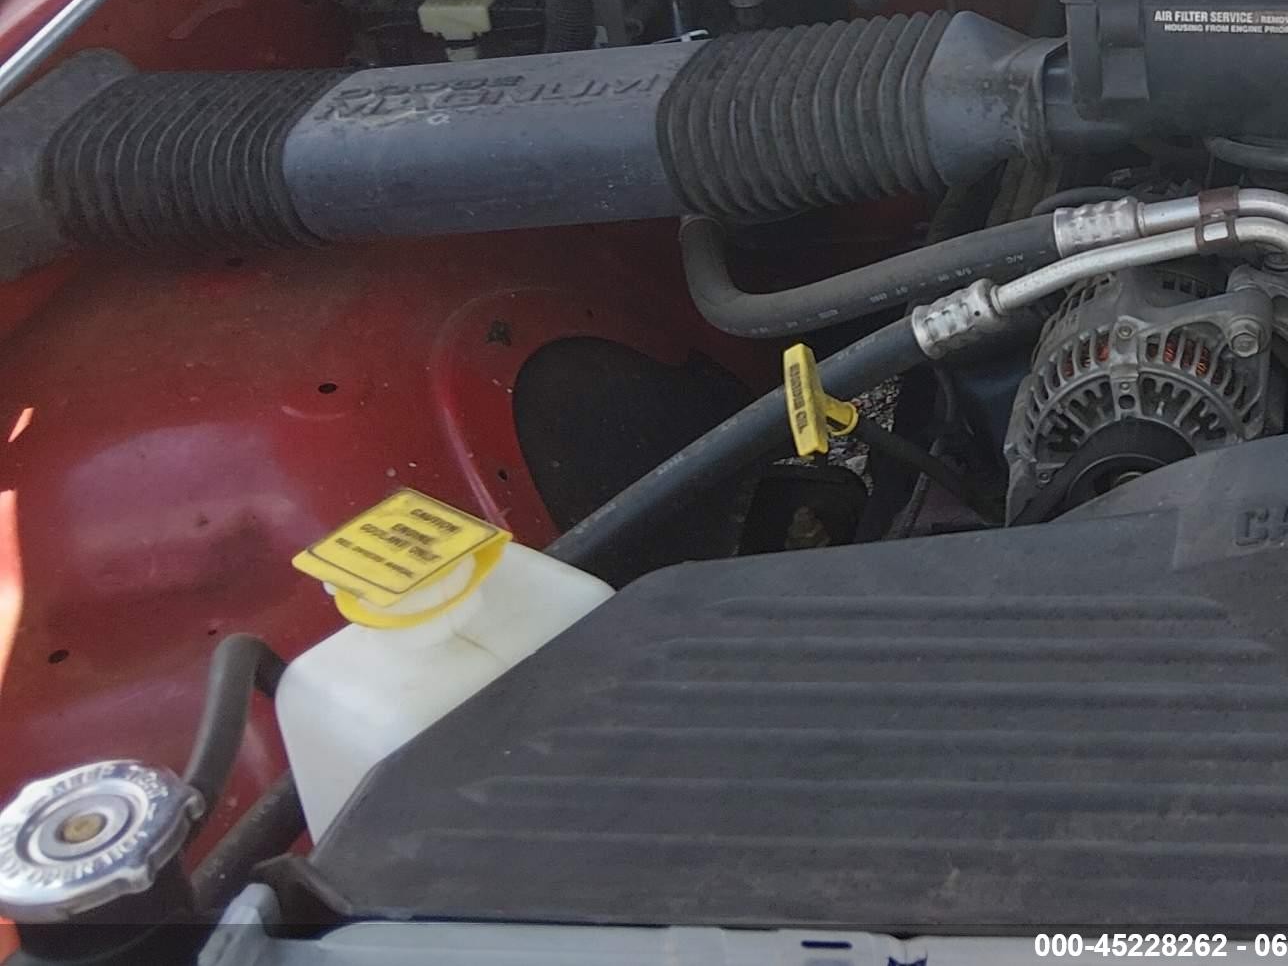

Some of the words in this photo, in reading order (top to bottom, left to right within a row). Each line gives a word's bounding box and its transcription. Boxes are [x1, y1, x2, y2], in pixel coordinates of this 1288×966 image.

[1154, 10, 1172, 22] AIR
[1174, 10, 1208, 23] FILTER
[1210, 11, 1253, 24] SERVICE
[1205, 24, 1230, 33] FROM
